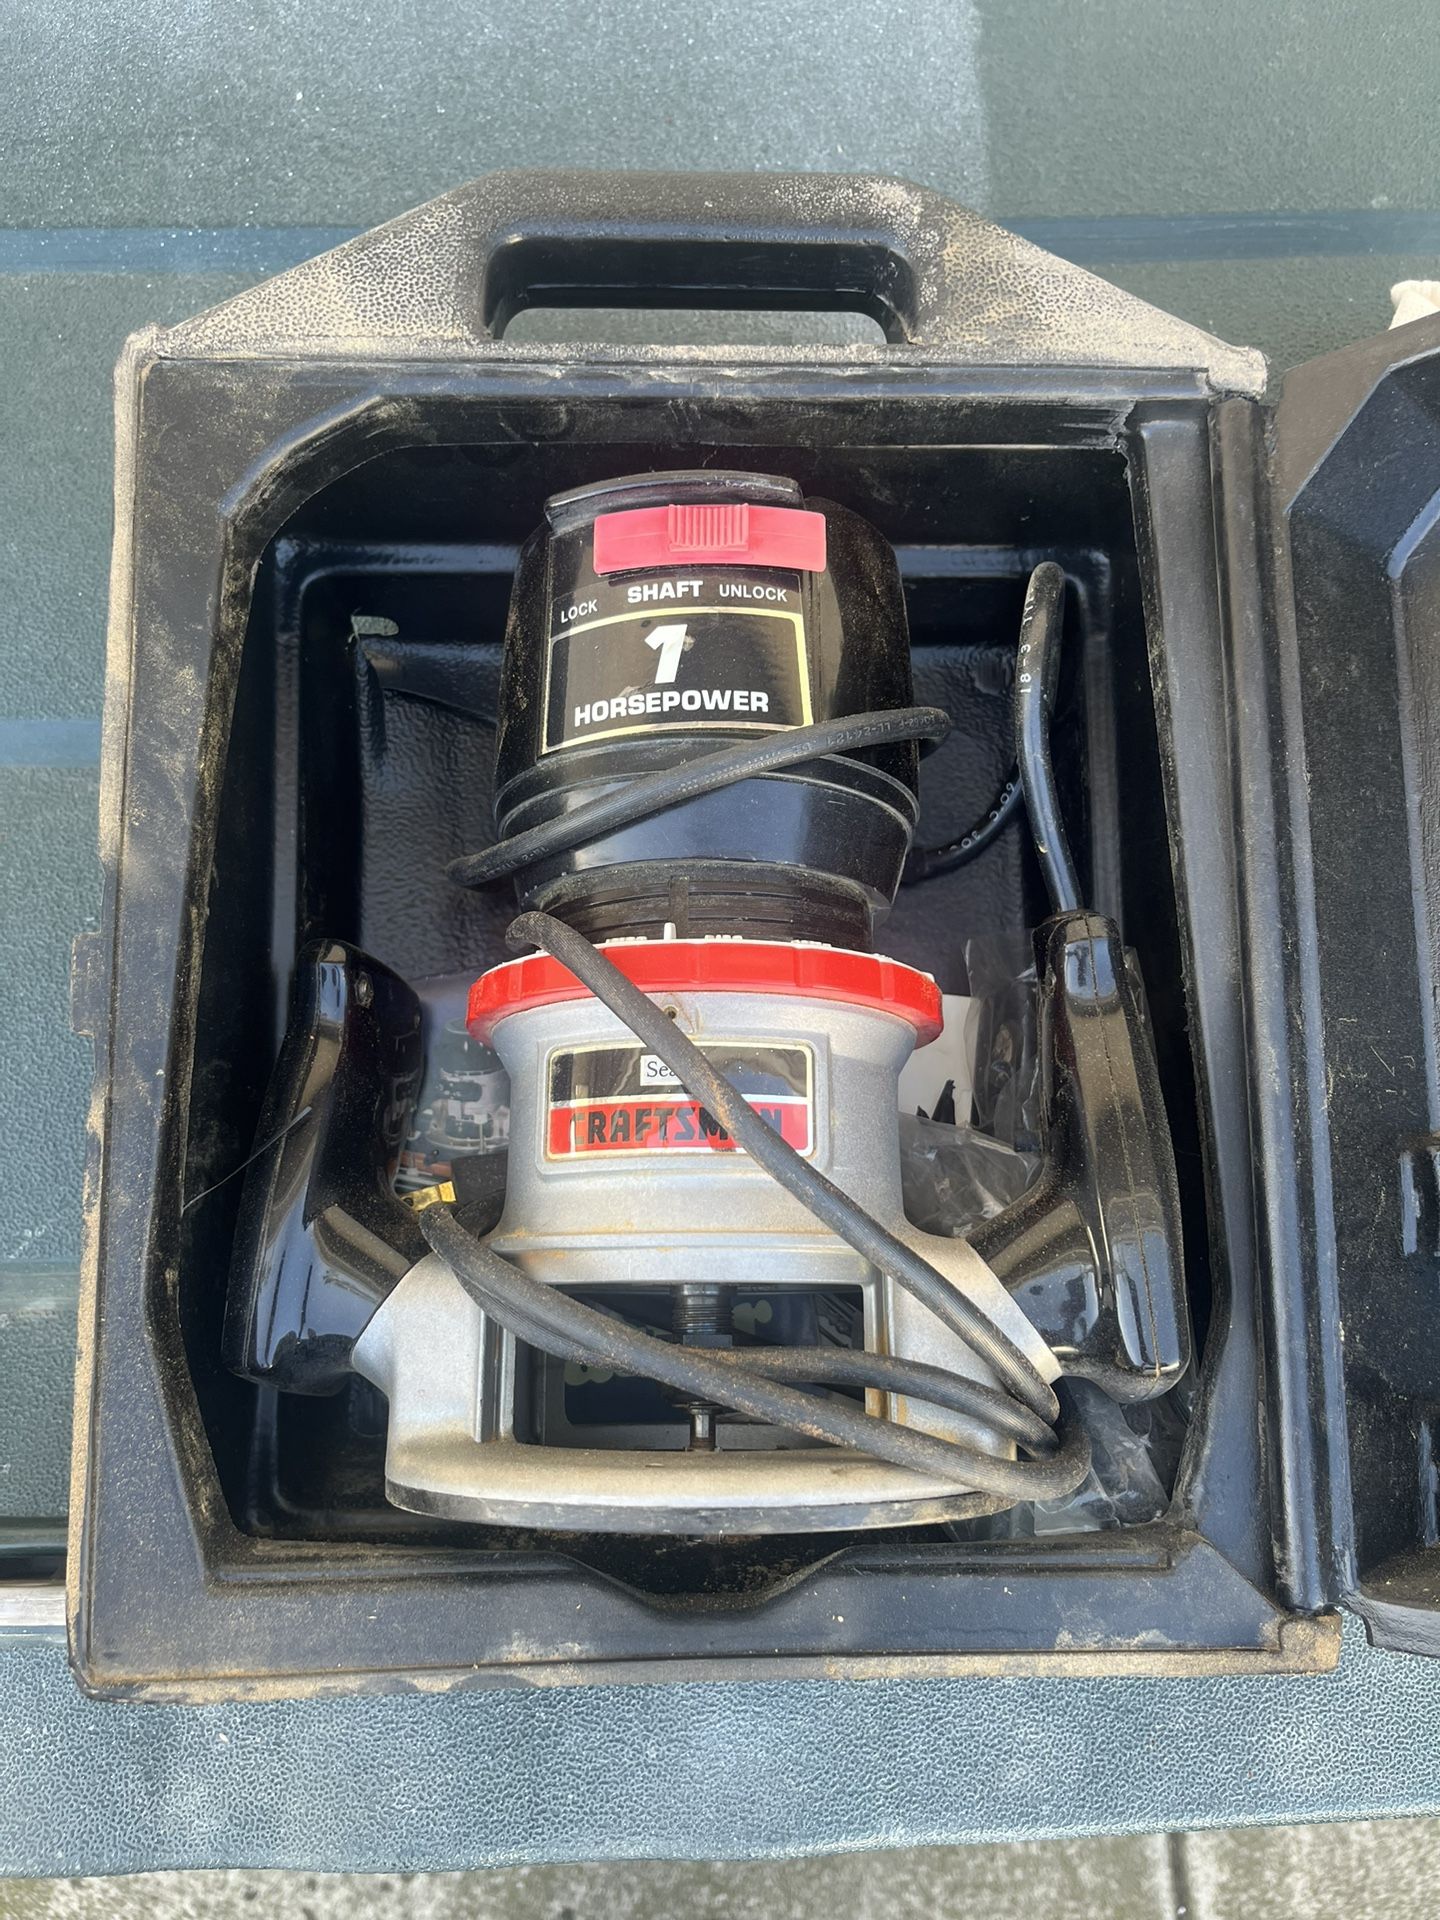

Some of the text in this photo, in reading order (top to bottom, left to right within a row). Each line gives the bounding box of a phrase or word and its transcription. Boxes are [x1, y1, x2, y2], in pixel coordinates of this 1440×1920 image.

[561, 580, 788, 624] LOCK SHAFT UNLOCK
[644, 623, 688, 684] 1
[574, 690, 769, 727] HORSEPOWER
[571, 1106, 782, 1145] CRAFTSMN
